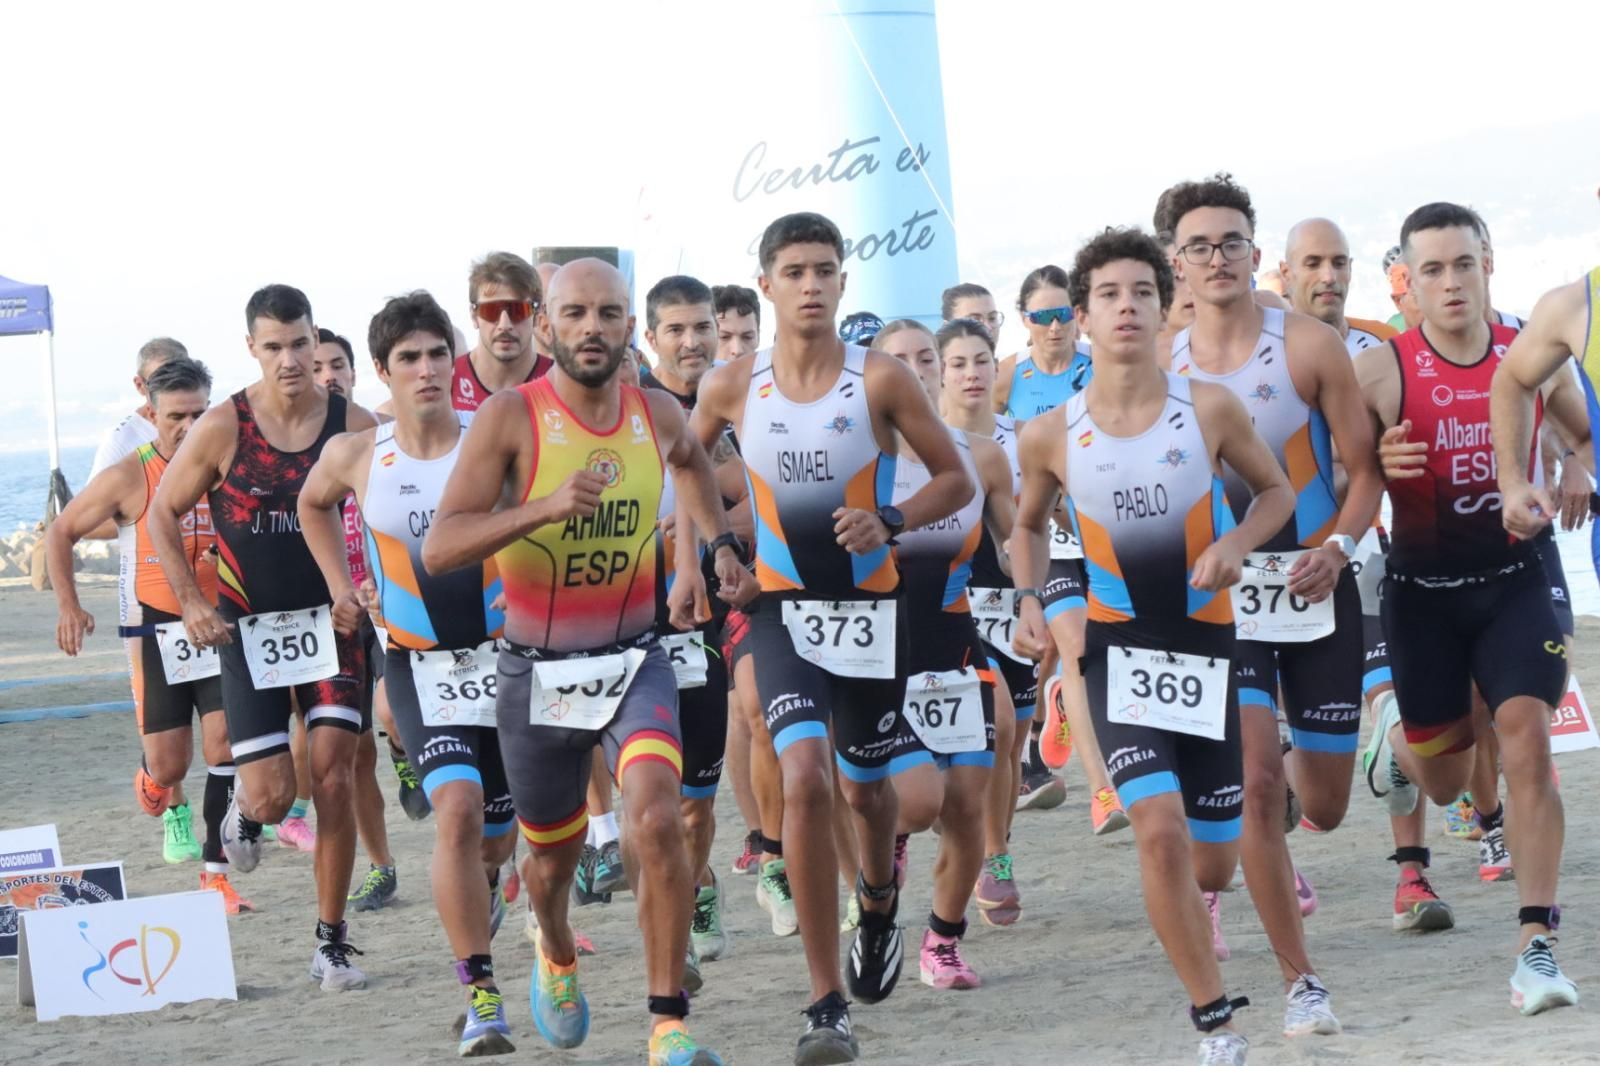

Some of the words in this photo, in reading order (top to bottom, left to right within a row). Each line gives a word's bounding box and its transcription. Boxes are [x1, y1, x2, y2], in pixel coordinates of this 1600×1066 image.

[777, 450, 835, 484] ISMAEL
[1113, 482, 1169, 522] PABLO
[408, 509, 436, 538] CA
[564, 551, 630, 587] ESP
[261, 631, 319, 665] 350
[804, 615, 874, 648] 373
[436, 674, 497, 701] 368
[1131, 669, 1203, 708] 369
[54, 874, 76, 885] DEL
